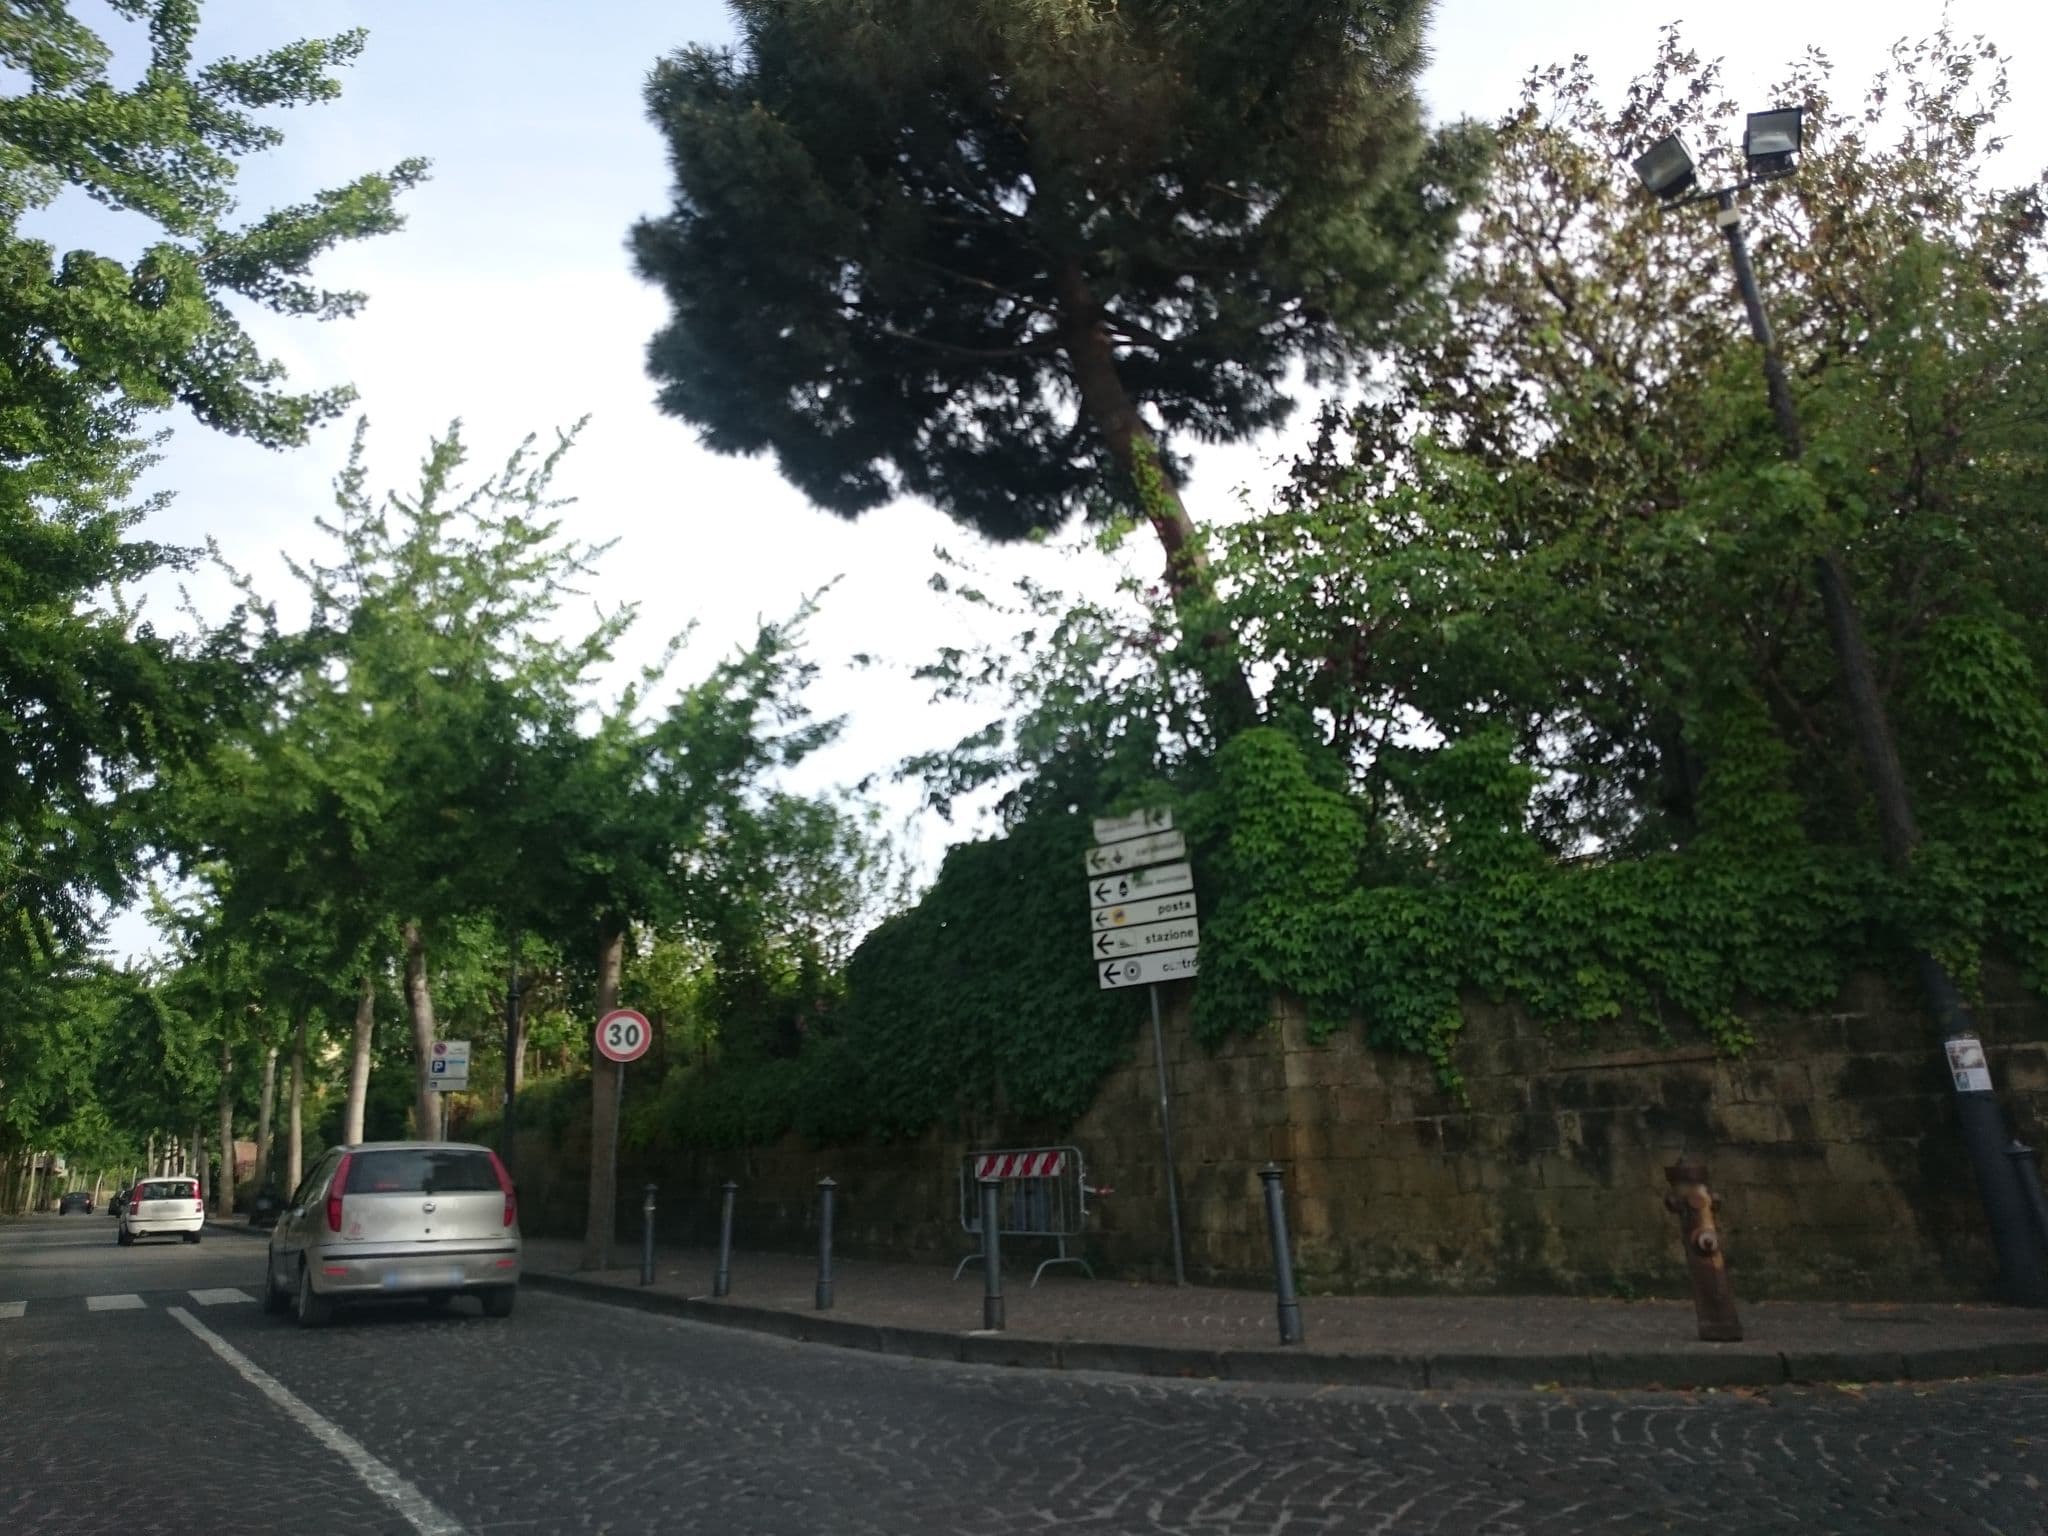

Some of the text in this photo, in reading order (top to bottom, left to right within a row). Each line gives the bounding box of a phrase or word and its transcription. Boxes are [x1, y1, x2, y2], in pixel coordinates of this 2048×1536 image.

[1158, 901, 1191, 915] posta
[1145, 929, 1194, 944] stazione
[1162, 959, 1199, 972] ctro
[609, 1024, 640, 1047] 30
